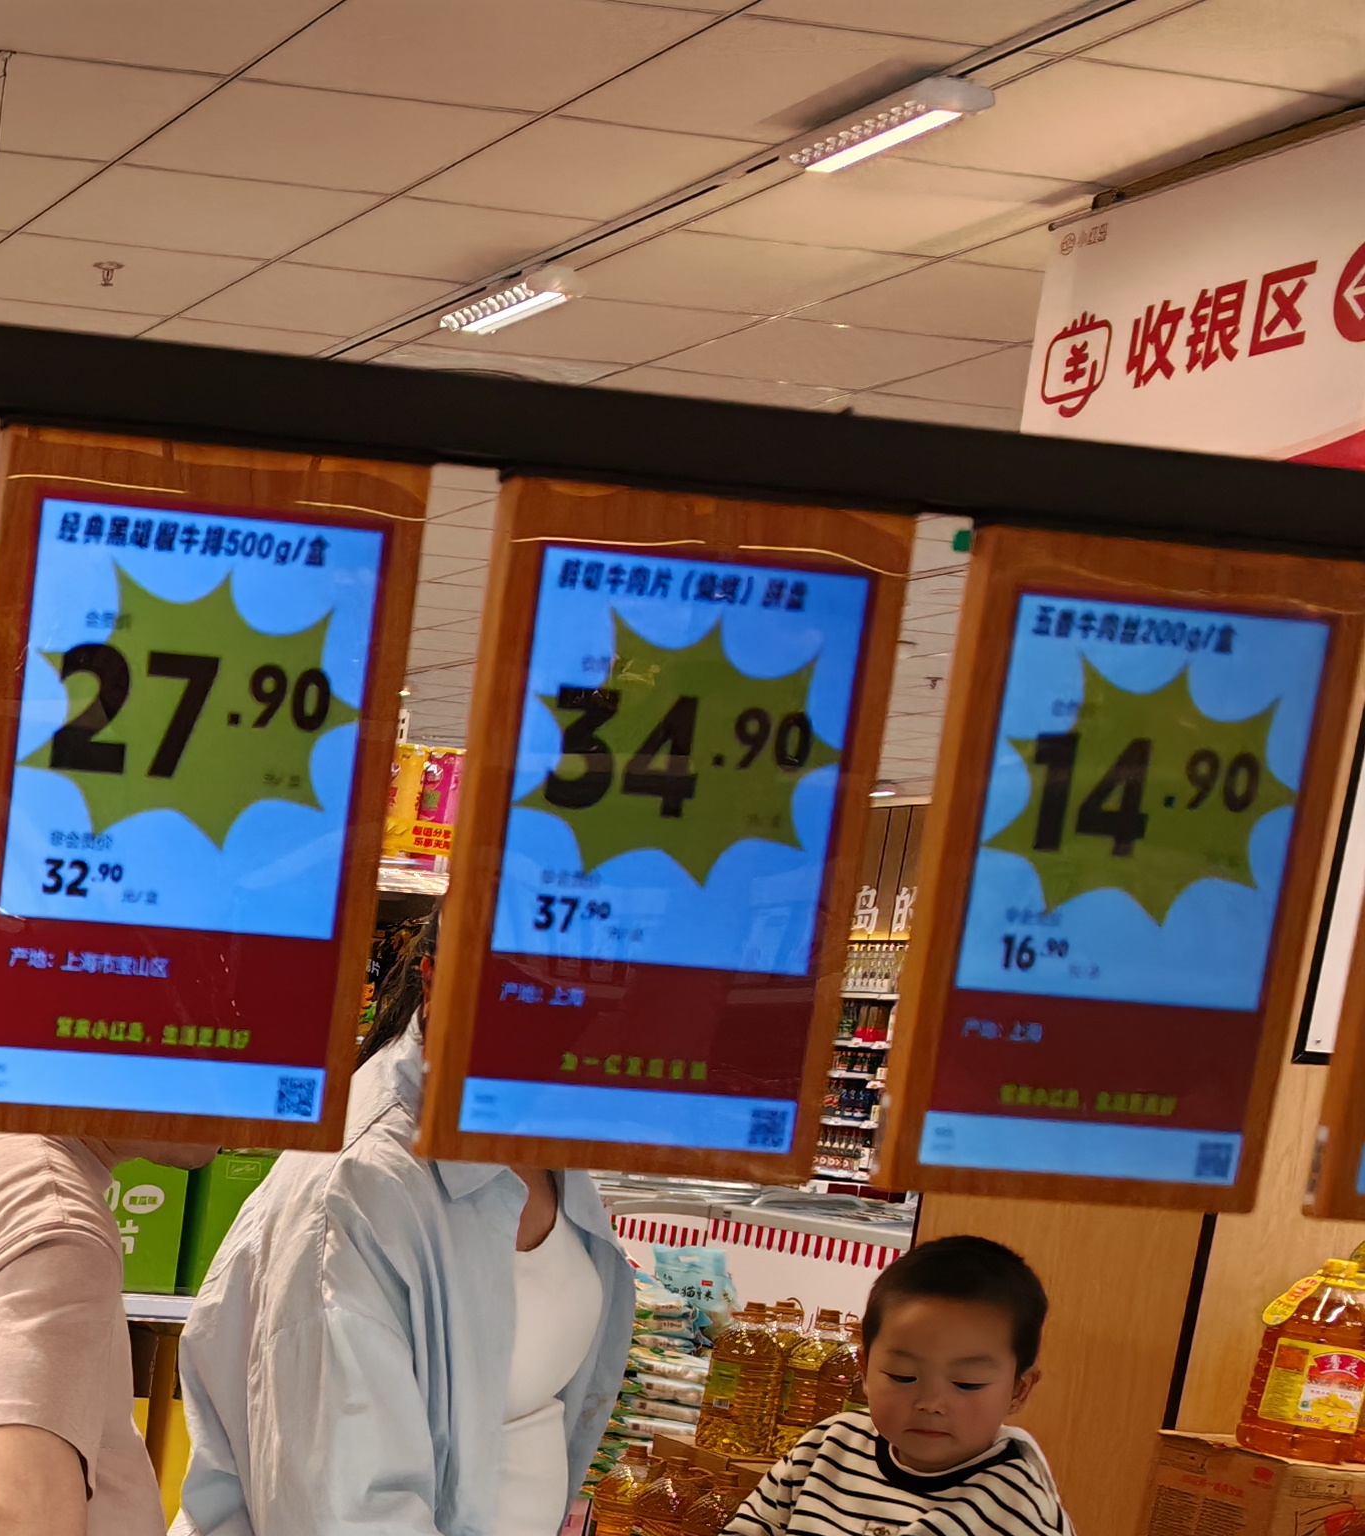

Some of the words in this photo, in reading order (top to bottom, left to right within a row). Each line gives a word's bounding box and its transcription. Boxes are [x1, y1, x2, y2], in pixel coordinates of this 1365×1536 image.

[1126, 260, 1318, 389] 收银区
[49, 642, 331, 778] 27.90
[544, 683, 813, 820] 34.90
[1032, 732, 1260, 858] 14.90
[41, 858, 123, 897] 32.90
